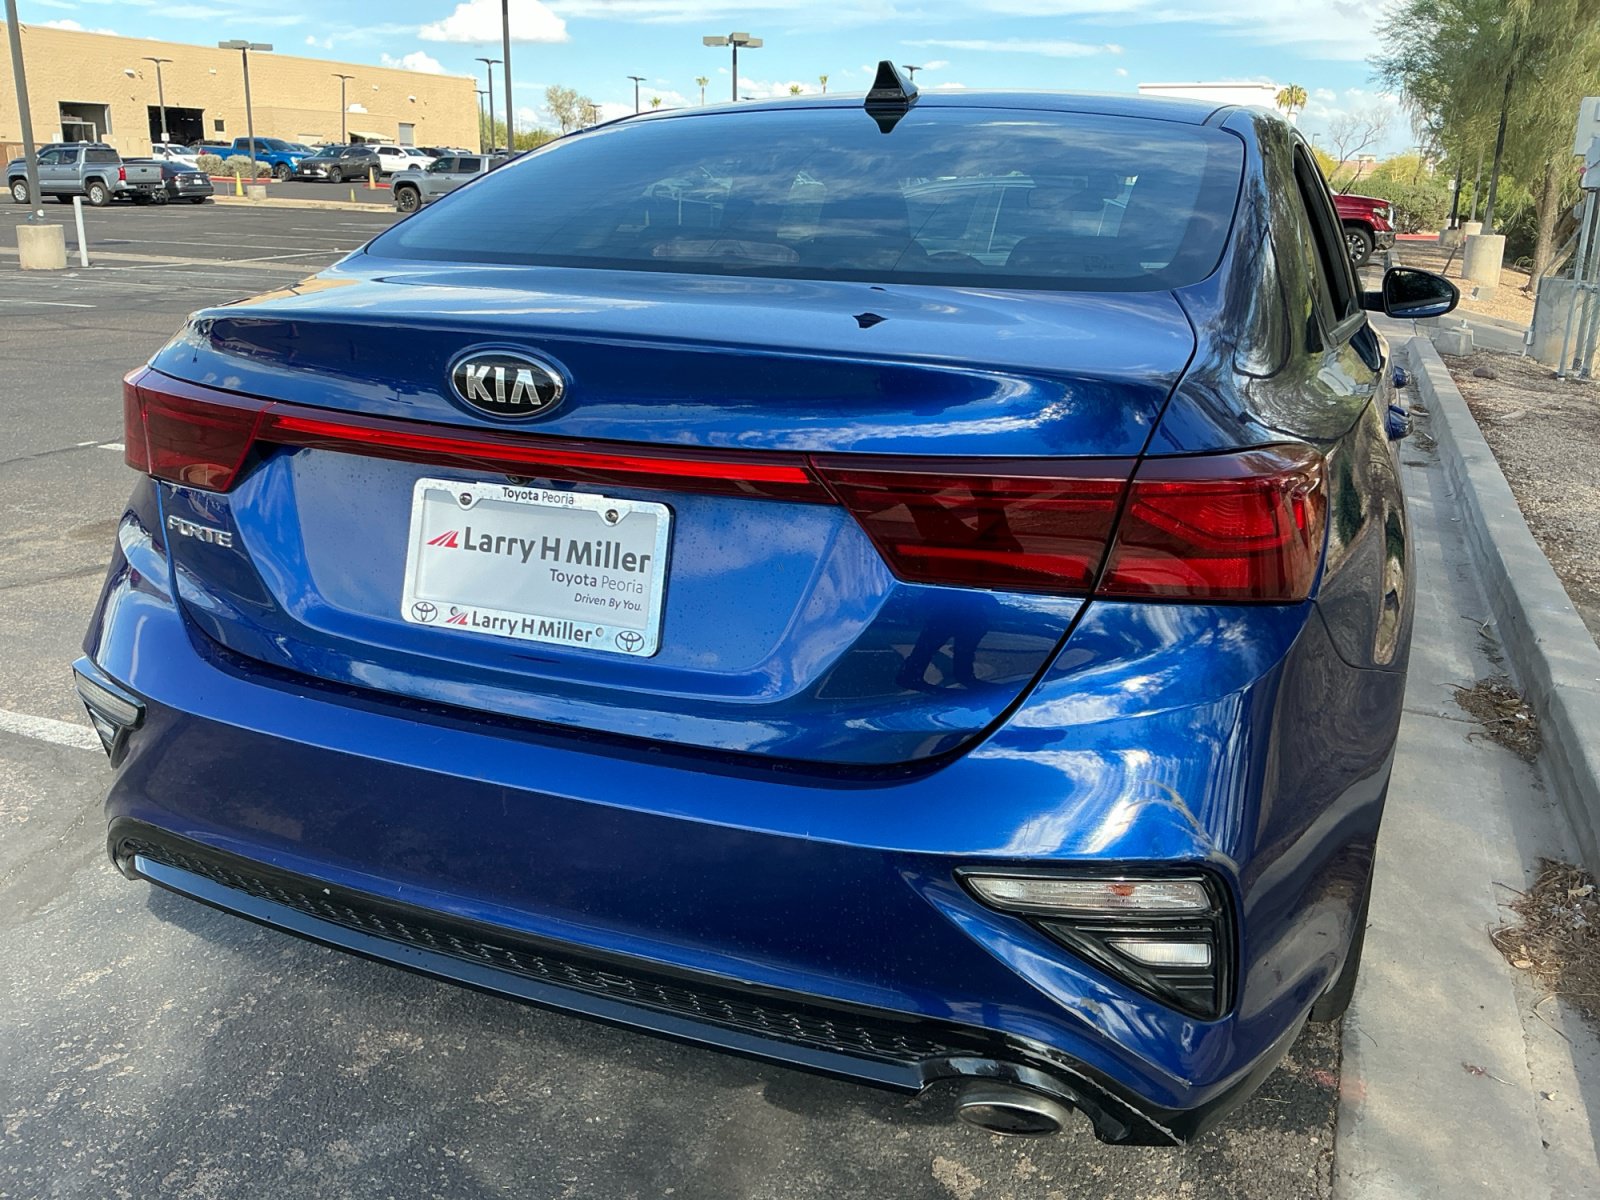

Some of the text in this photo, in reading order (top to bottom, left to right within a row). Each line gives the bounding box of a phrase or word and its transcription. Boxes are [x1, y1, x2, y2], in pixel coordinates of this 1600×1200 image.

[465, 364, 541, 405] KIA
[502, 486, 574, 505] Toyota Peoria
[166, 514, 233, 548] FORTE
[463, 526, 651, 573] Larry H Miller
[550, 568, 643, 594] Toyota Peoria
[574, 592, 642, 611] Driven By You.
[472, 611, 593, 643] Larry H Miller
